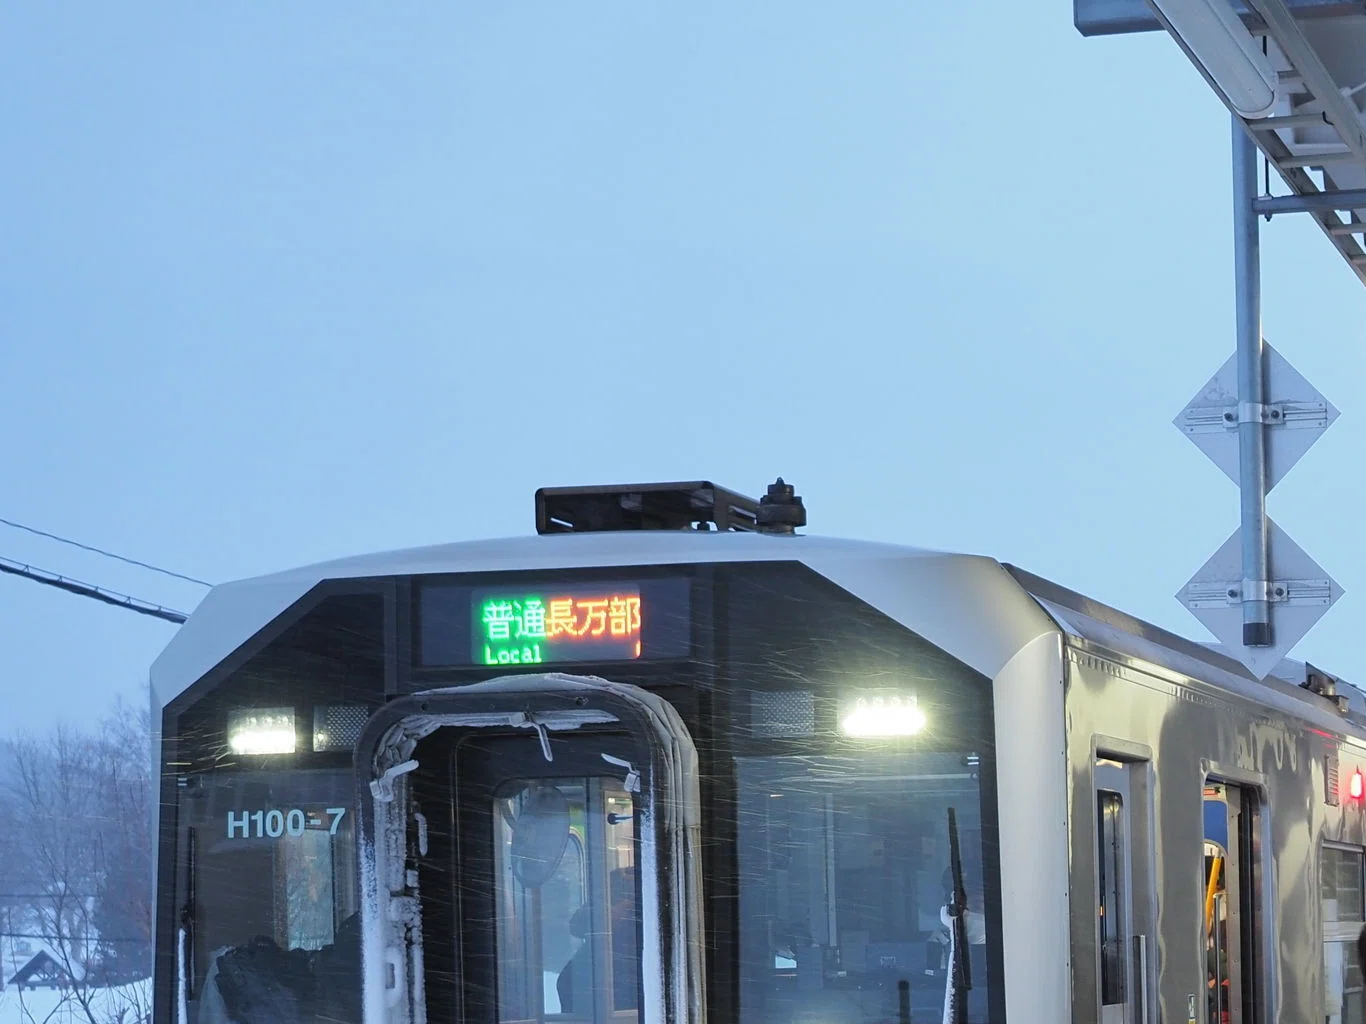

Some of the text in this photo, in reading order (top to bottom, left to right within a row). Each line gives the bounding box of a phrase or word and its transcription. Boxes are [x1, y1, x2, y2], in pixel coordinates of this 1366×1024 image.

[546, 597, 640, 636] 長万部
[485, 644, 542, 665] Local
[227, 807, 346, 839] H100-7
